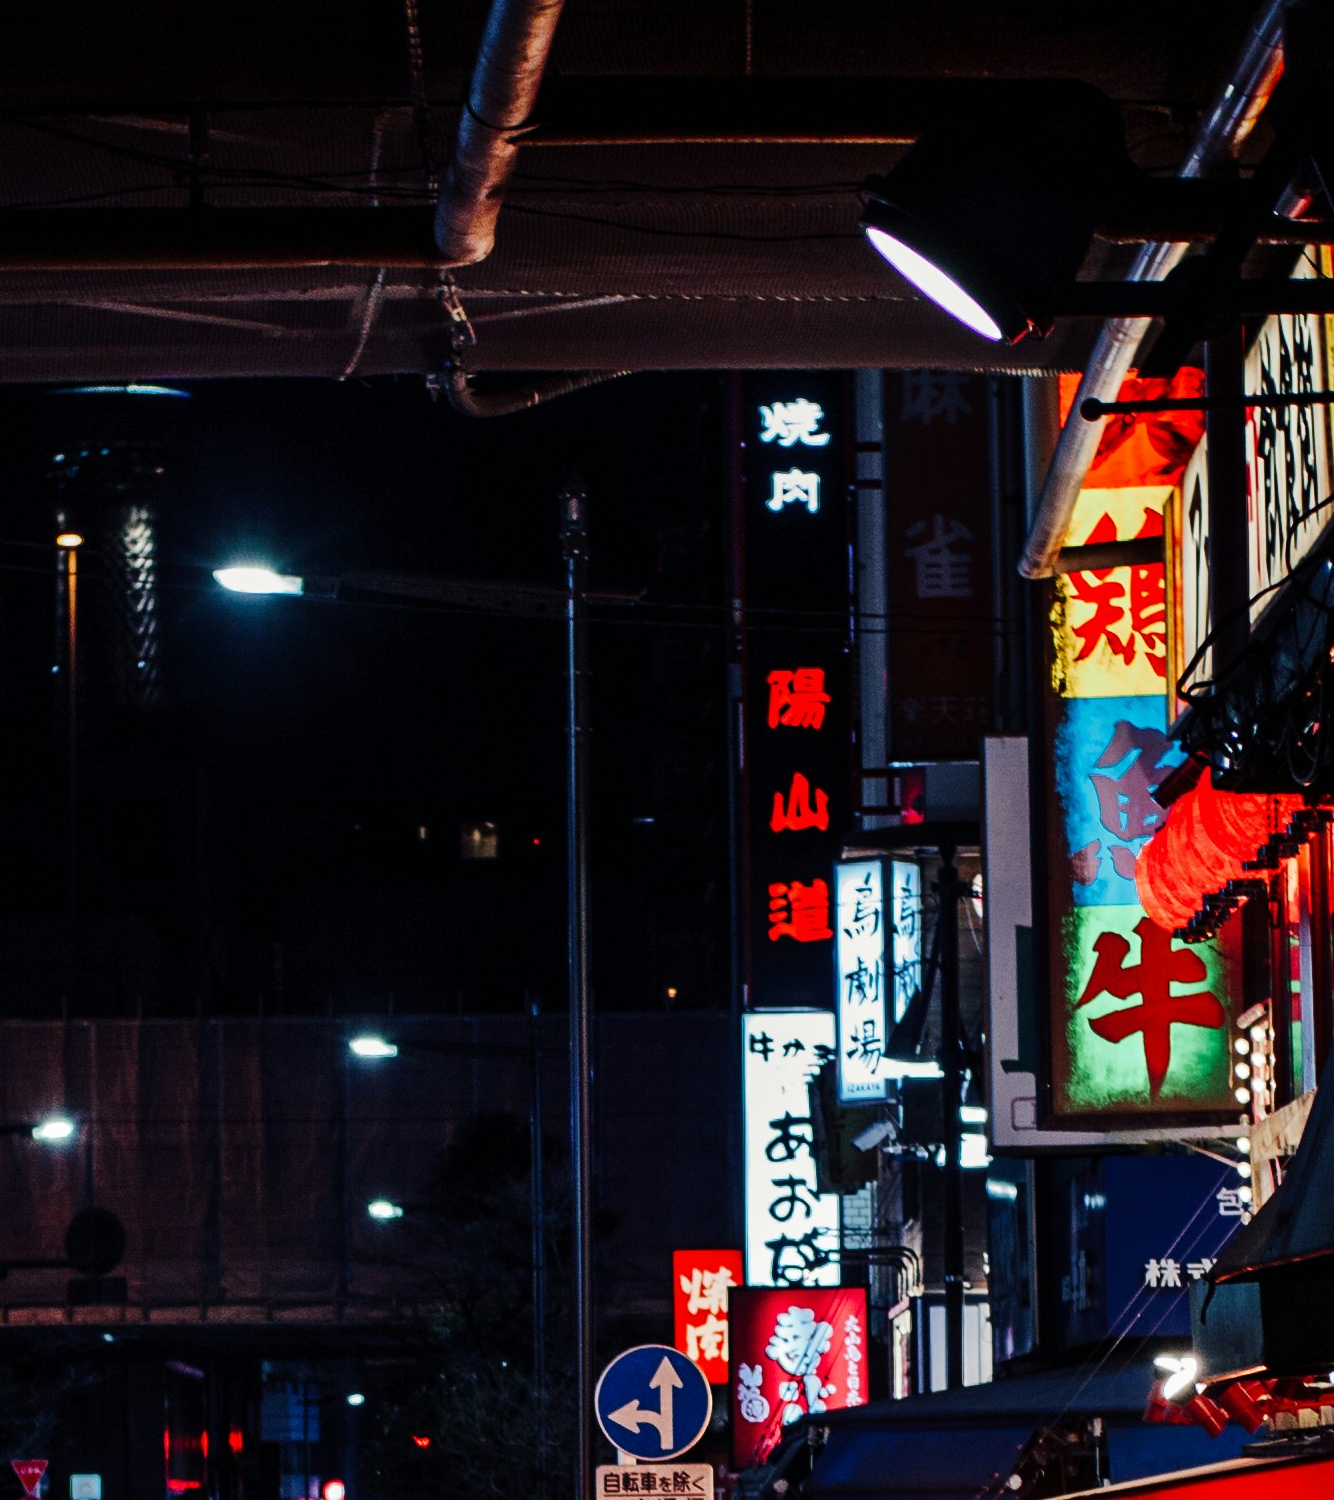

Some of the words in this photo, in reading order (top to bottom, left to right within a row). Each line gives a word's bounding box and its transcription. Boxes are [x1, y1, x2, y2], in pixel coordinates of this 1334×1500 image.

[757, 397, 831, 514] 焼肉
[767, 667, 835, 944] 陽山道
[847, 1082, 881, 1093] IZAKAYA
[603, 1470, 706, 1493] 自転車を除く
